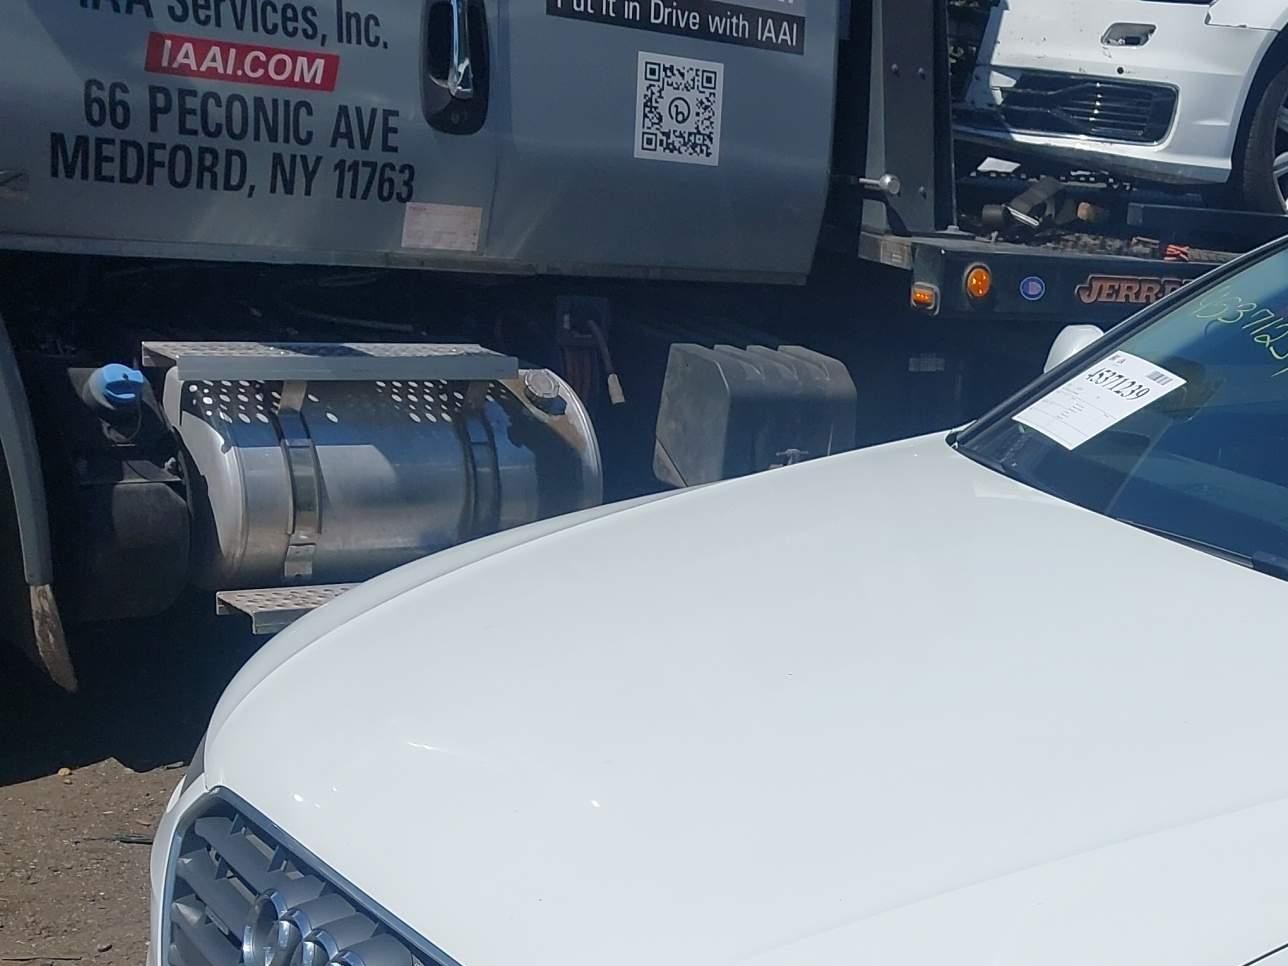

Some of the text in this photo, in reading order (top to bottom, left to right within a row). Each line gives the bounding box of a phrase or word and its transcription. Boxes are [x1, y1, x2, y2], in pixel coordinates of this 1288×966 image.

[336, 0, 389, 49] Inc.
[624, 0, 640, 21] in
[650, 1, 700, 30] Drive
[708, 11, 749, 39] with
[757, 17, 797, 46] IAAI
[160, 39, 326, 85] IAAI.COM
[83, 78, 400, 153] 66 PECONIC AVE
[50, 131, 416, 203] MEDFORD, NY 11763
[1085, 367, 1151, 401] 45371239
